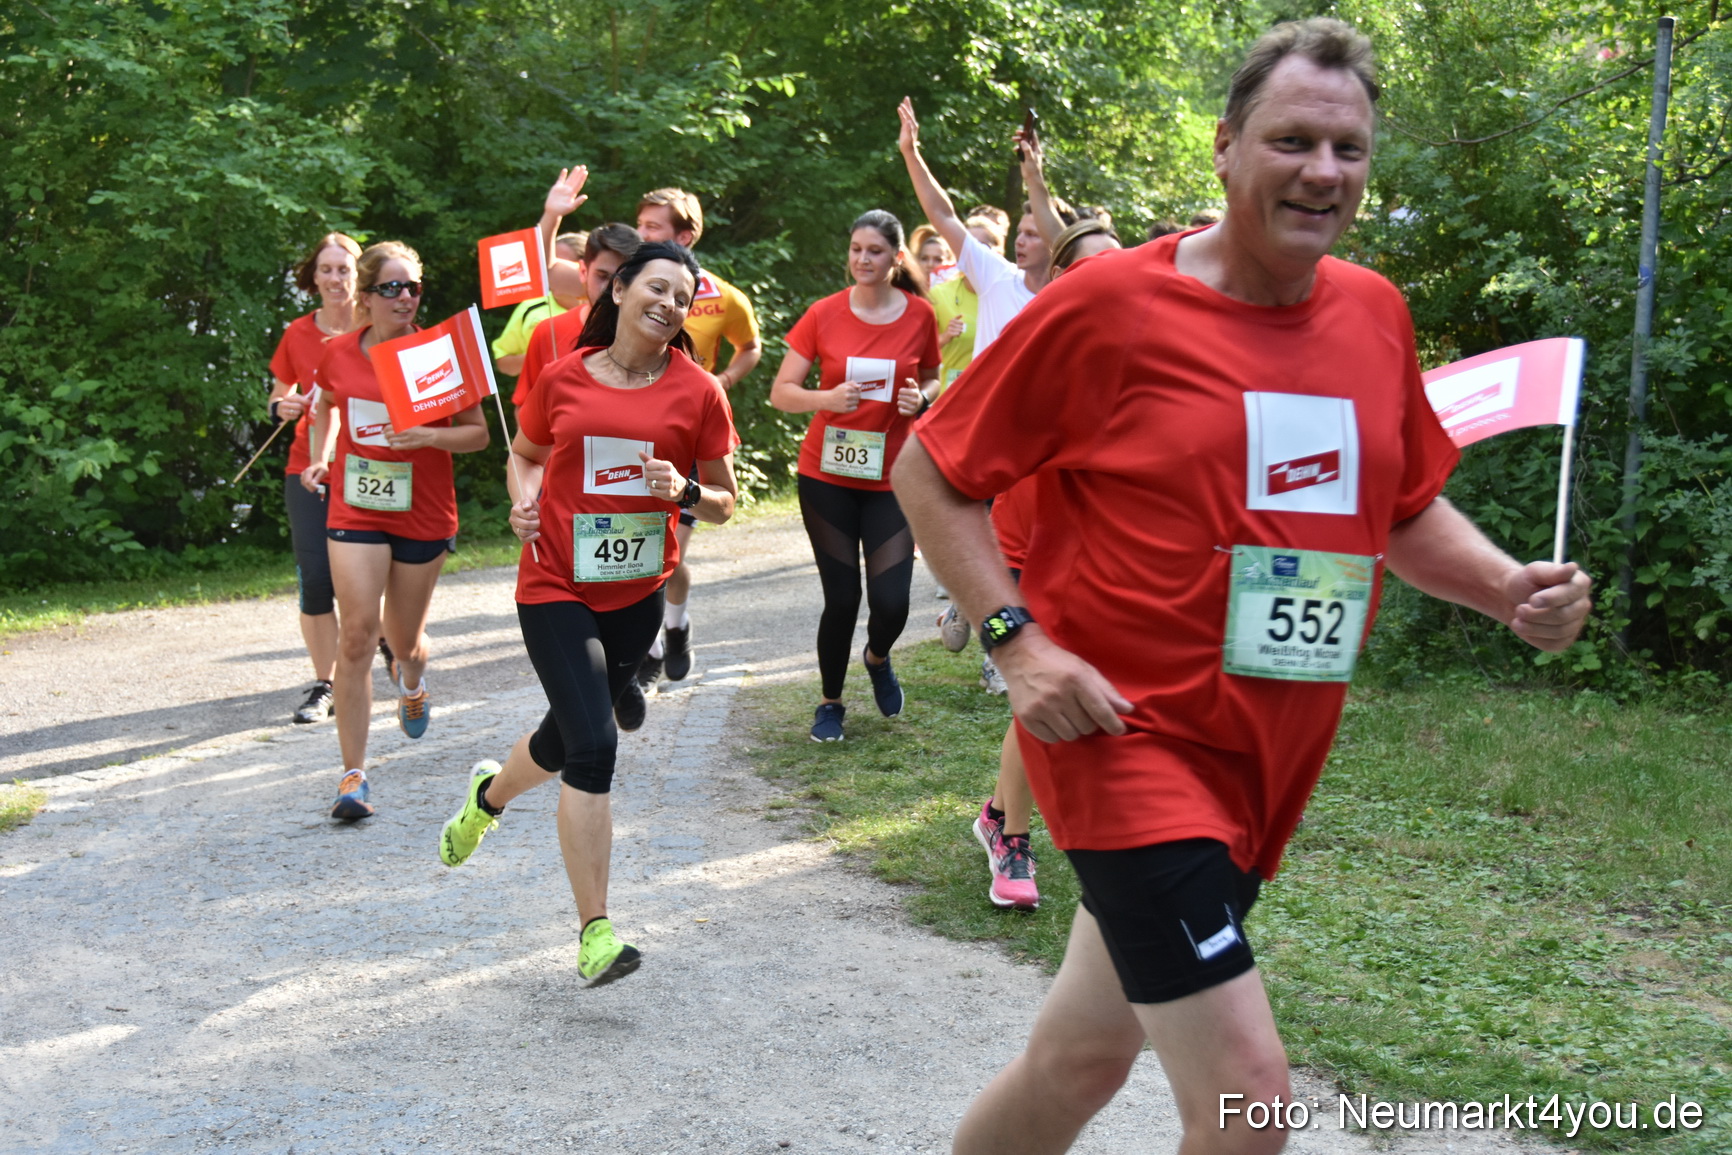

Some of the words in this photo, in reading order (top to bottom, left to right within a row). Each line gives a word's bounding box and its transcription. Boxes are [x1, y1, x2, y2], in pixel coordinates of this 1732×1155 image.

[687, 303, 725, 317] ÖGL
[413, 399, 437, 413] DEHN
[438, 388, 467, 407] protects.
[834, 445, 868, 465] 503
[607, 468, 631, 481] DEHN
[357, 476, 395, 497] 524
[594, 537, 646, 563] 497
[597, 563, 626, 571] Himmler
[628, 561, 644, 569] Ilona
[1267, 596, 1345, 646] 552
